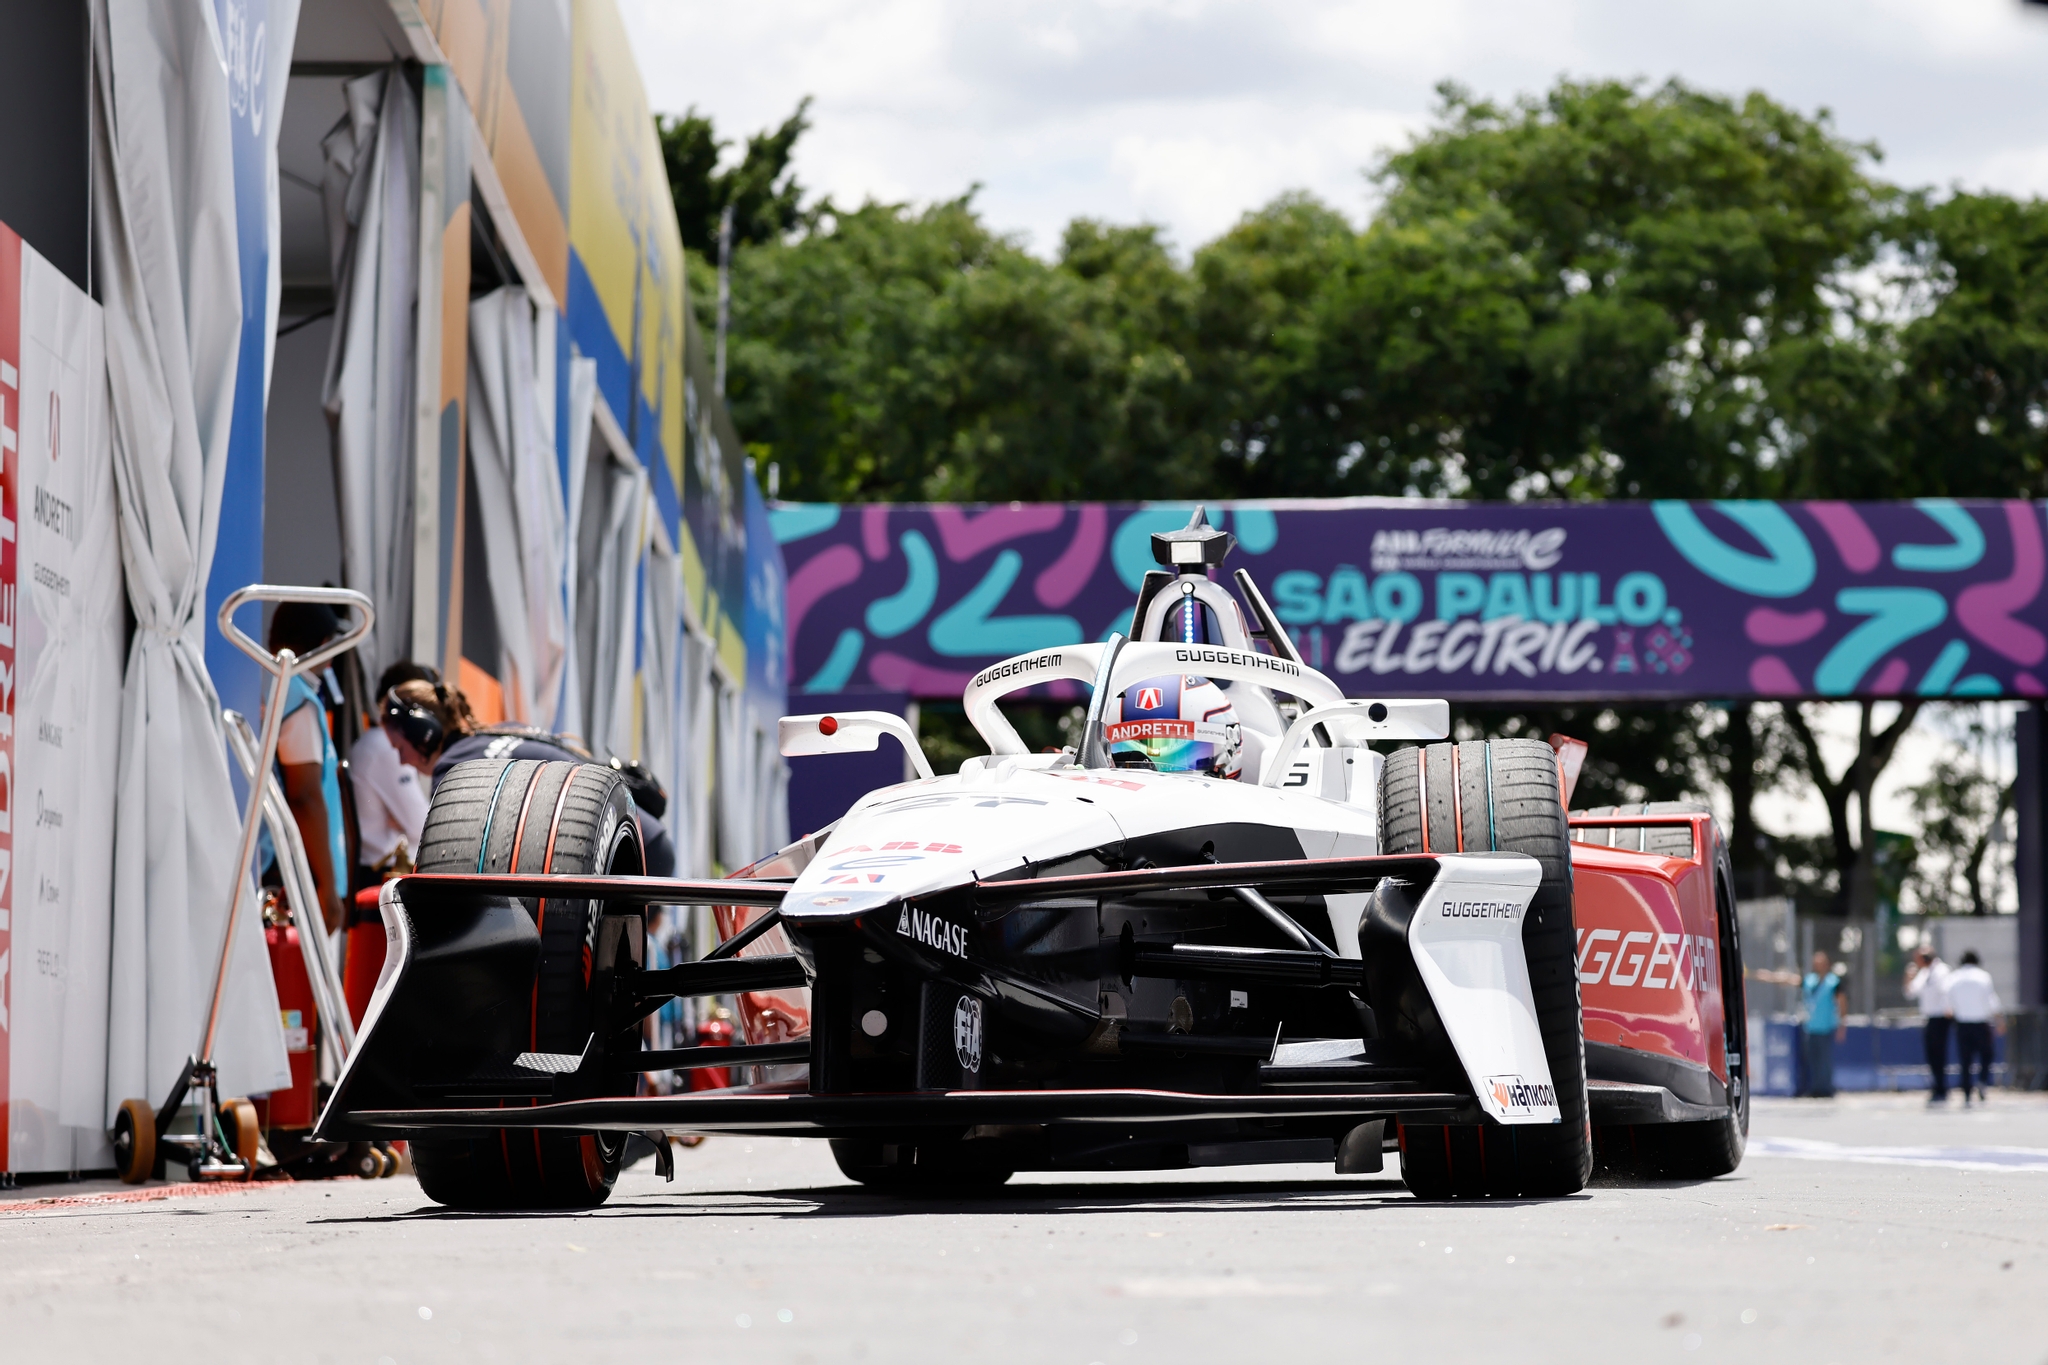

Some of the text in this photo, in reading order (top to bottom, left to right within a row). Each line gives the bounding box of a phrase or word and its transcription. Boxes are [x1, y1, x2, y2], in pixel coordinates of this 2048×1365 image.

[34, 484, 73, 541] ANDRETTI
[1272, 564, 1682, 627] SÃO PAULO.
[1176, 649, 1300, 677] GUGGENHEIM
[1335, 617, 1604, 677] ELECTRIC.
[976, 654, 1062, 688] GUGGENHEIM
[1111, 722, 1188, 741] ANDRETTI
[826, 841, 963, 858] ABB
[1442, 902, 1522, 919] GUGGENHEIM
[912, 907, 968, 959] NAGASE
